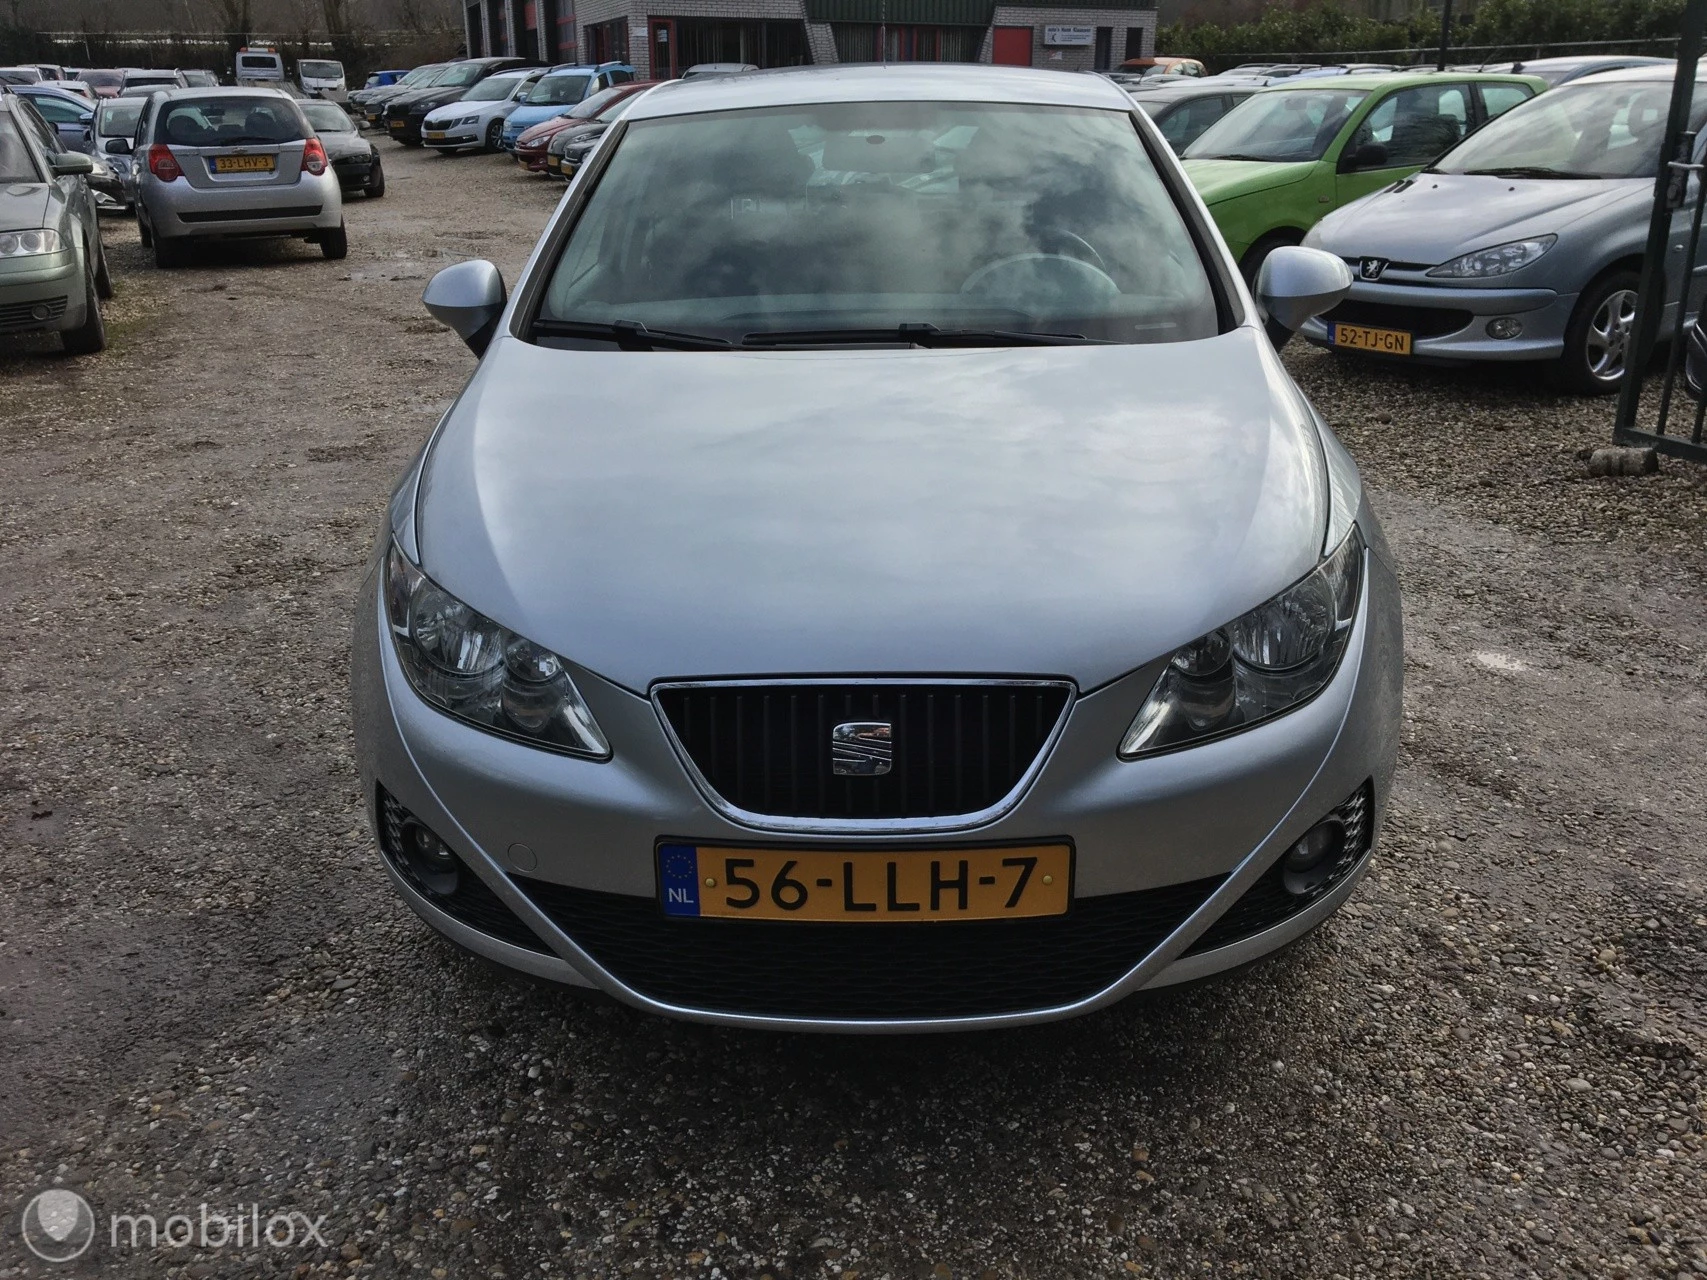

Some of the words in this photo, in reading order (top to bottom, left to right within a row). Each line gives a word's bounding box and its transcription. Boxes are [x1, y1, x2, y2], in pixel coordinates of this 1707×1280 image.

[219, 157, 269, 169] 33-LHV-3
[1340, 327, 1404, 351] 52-TJ-GN
[725, 856, 1038, 912] 56-LLH-7
[667, 887, 695, 904] NL
